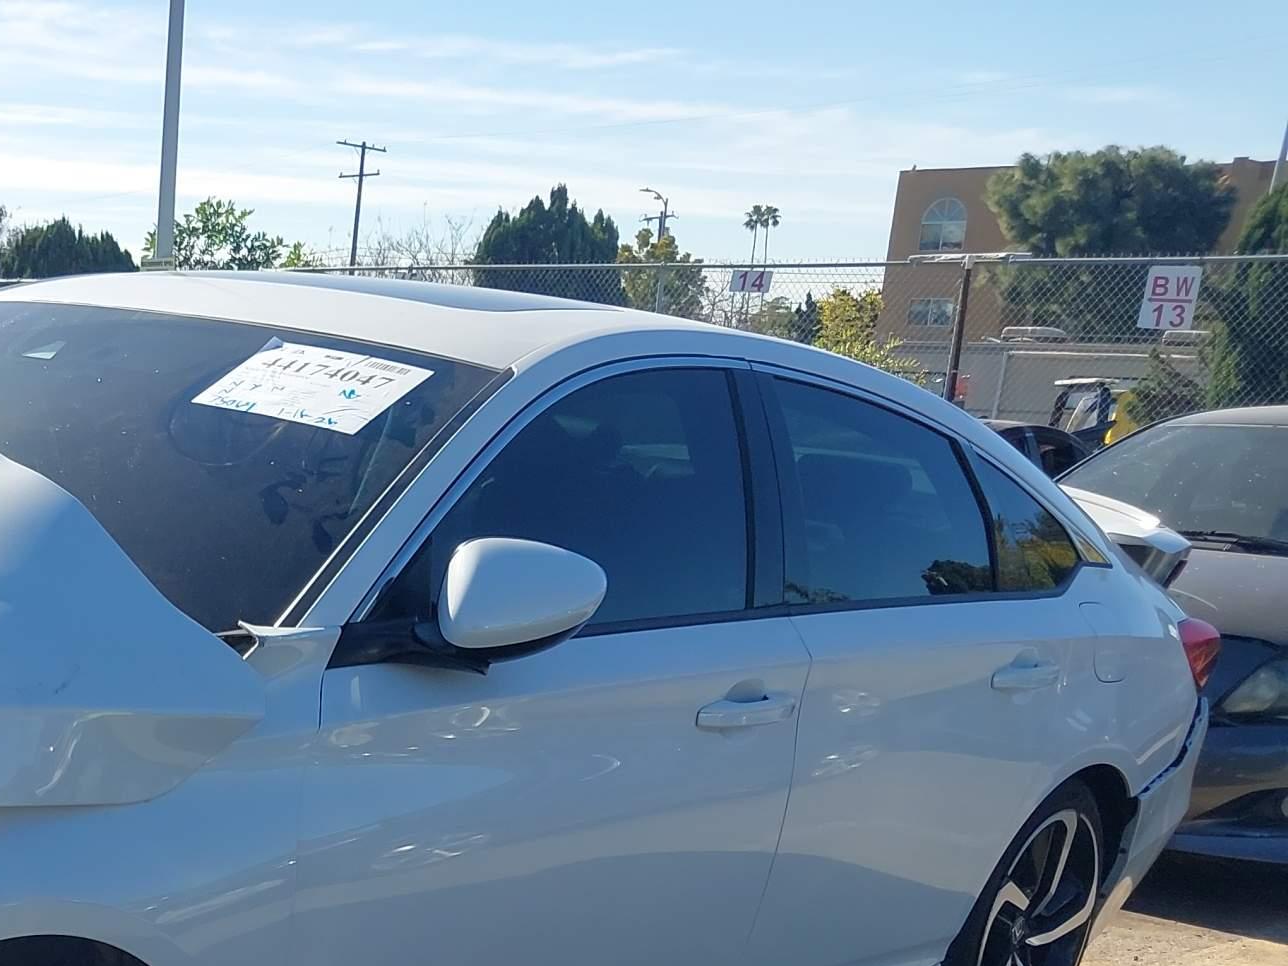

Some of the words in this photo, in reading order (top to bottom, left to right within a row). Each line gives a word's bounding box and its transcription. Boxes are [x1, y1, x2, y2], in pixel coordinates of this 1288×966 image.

[739, 271, 764, 292] 14
[1151, 276, 1196, 297] BW
[1152, 304, 1186, 328] 13
[262, 357, 395, 389] 44174047
